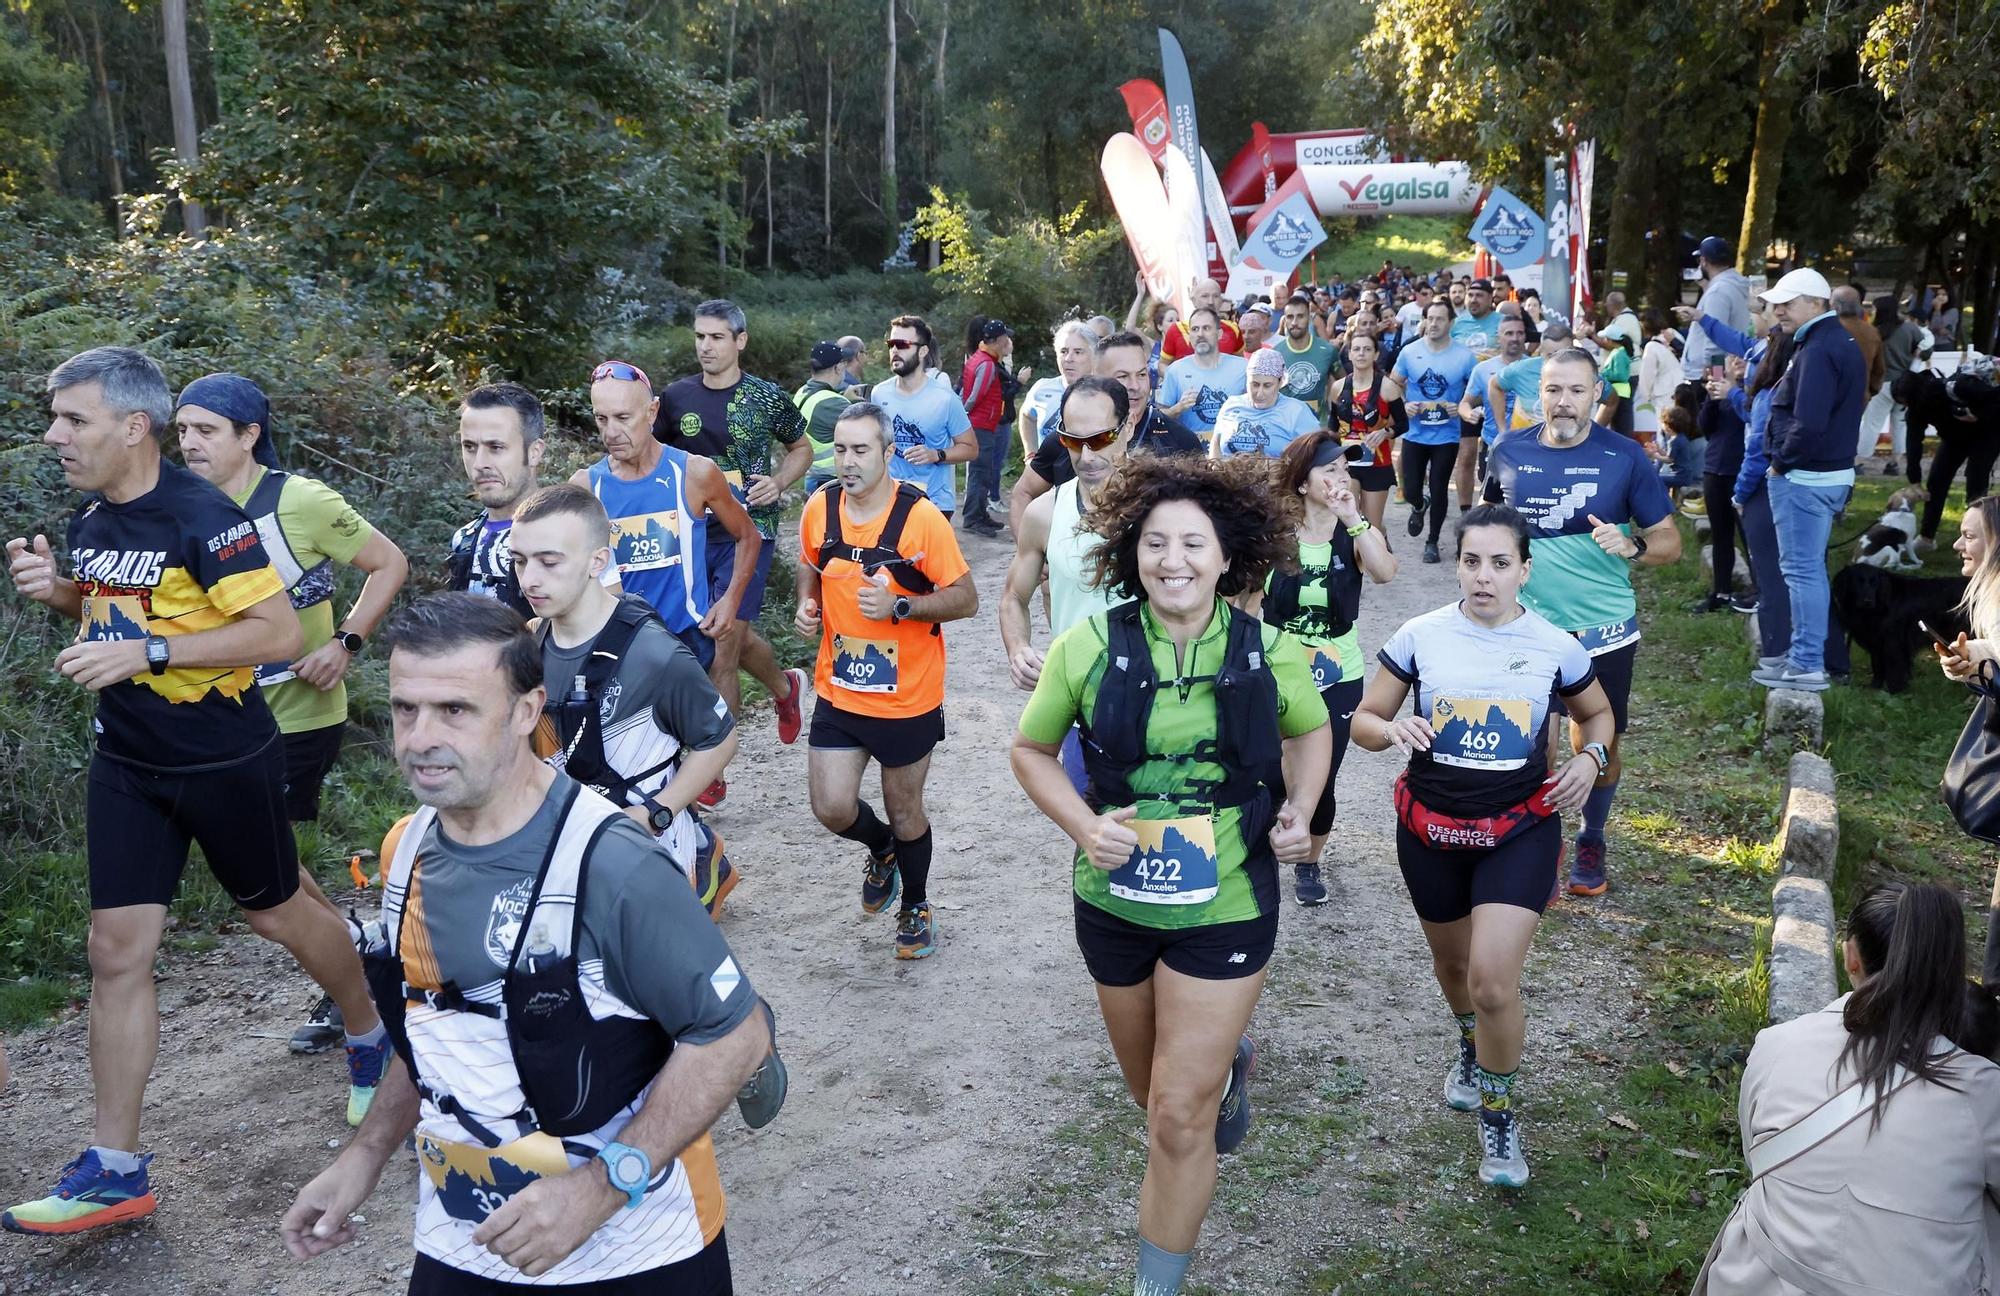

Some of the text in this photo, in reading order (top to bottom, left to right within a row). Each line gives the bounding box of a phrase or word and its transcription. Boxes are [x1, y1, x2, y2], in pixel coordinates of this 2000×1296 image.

[1339, 174, 1449, 206] Vegalsa
[1297, 231, 1312, 240] VIGO
[1519, 228, 1534, 237] VIGO
[207, 536, 221, 552] OS
[630, 538, 661, 556] 295
[217, 545, 235, 561] DOS
[630, 552, 666, 563] CARLOCHAS
[1598, 622, 1626, 639] 223
[847, 661, 876, 678] 409
[1459, 730, 1501, 752] 469
[1463, 749, 1496, 760] Mariana
[1428, 831, 1495, 847] VERTICE
[1135, 858, 1183, 881] 422
[493, 895, 529, 916] NOCE
